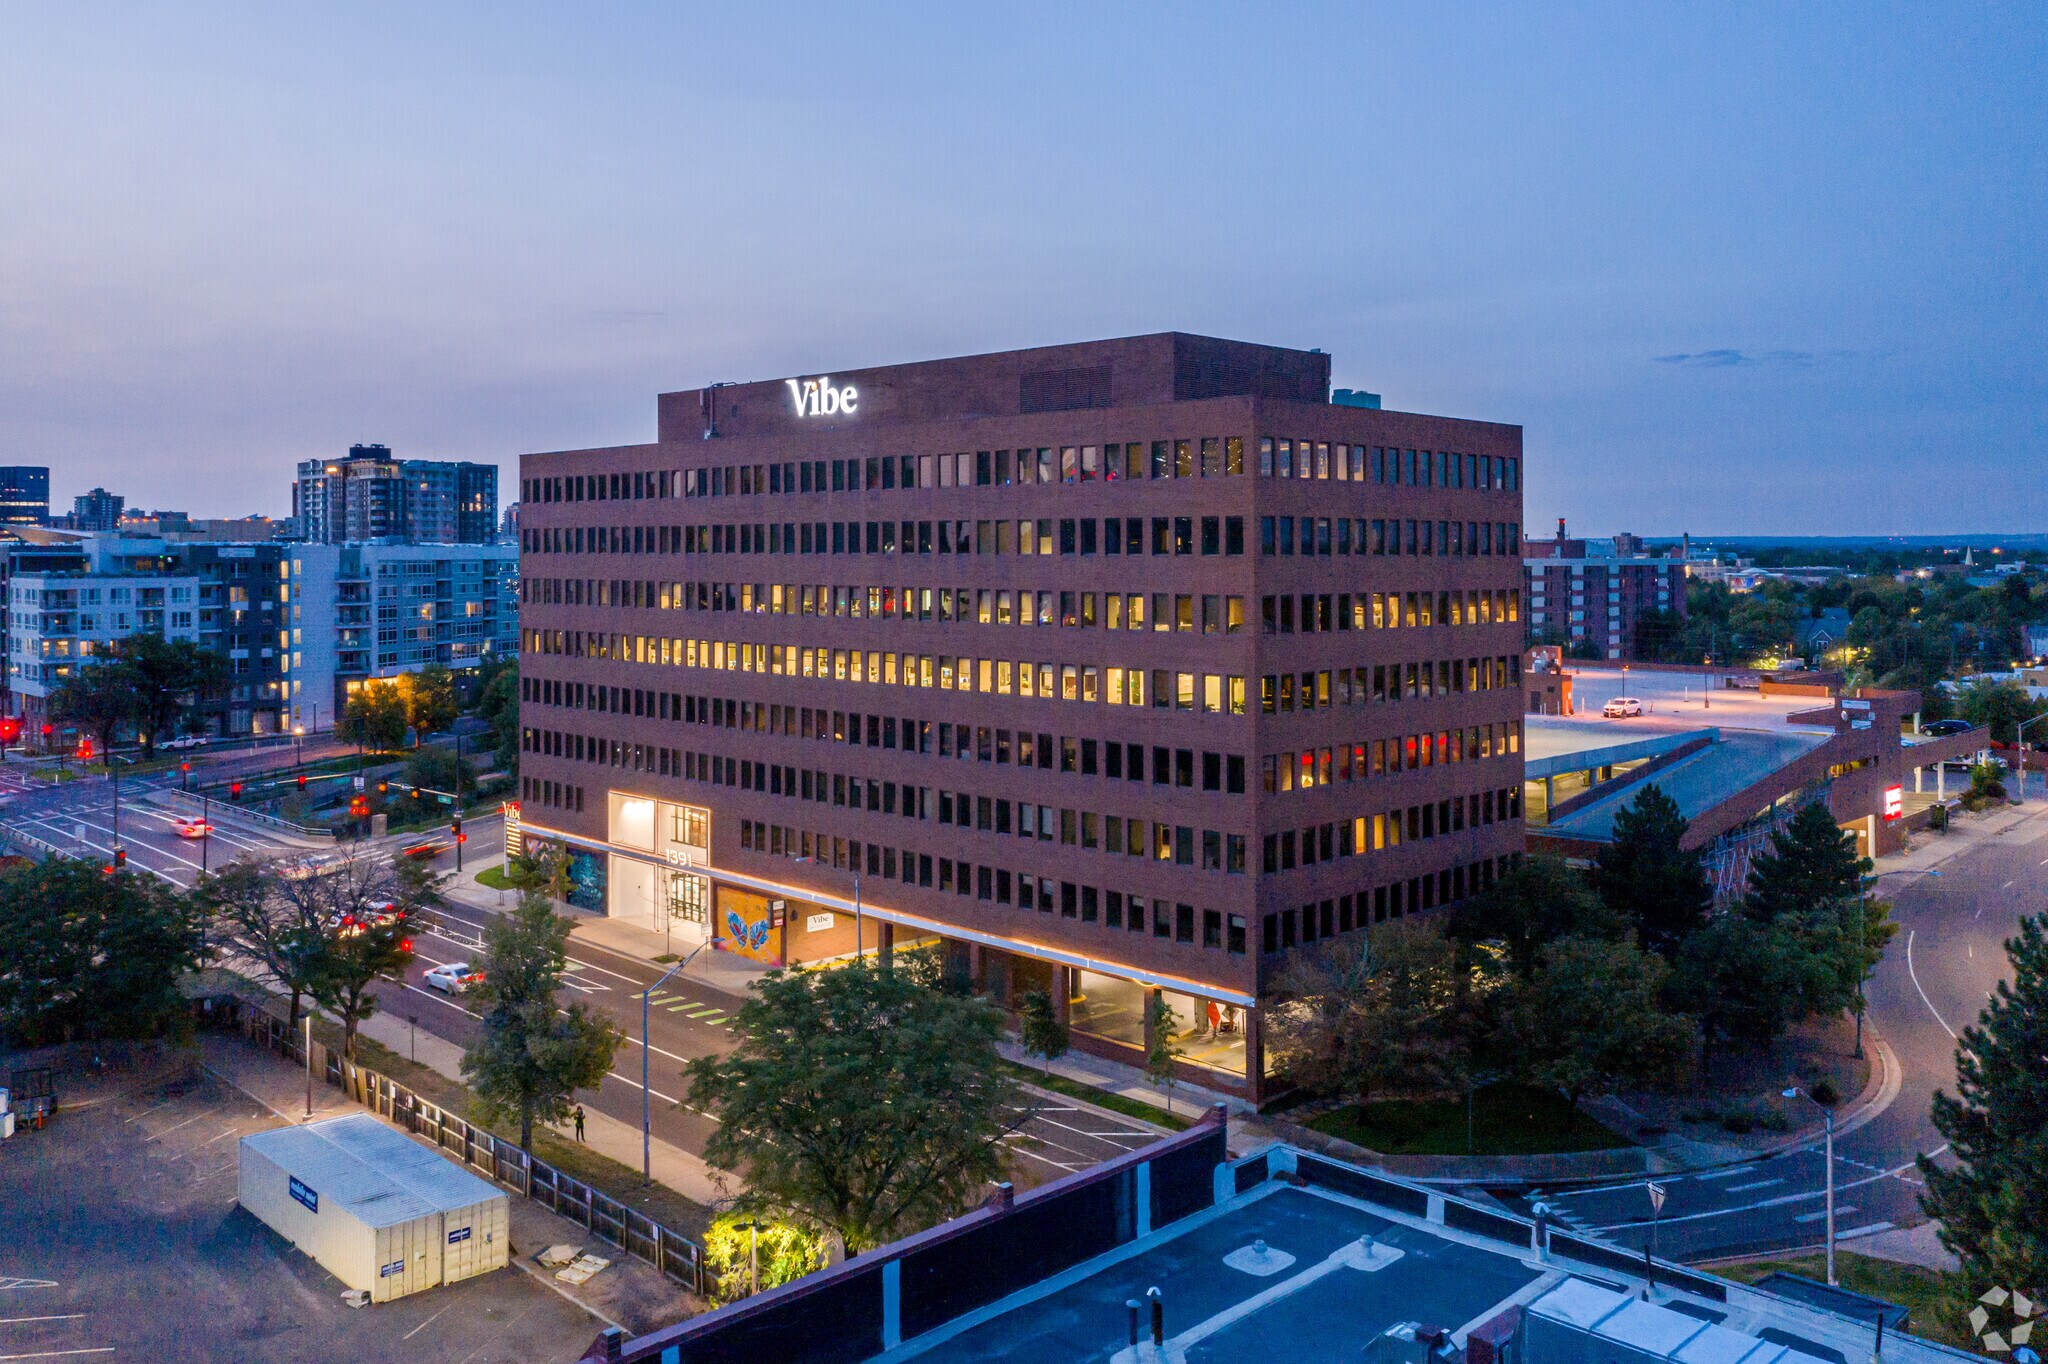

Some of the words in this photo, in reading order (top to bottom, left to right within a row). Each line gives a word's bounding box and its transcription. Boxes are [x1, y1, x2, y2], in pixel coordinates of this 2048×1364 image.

[785, 376, 858, 417] Vibe
[665, 848, 692, 867] 1391
[813, 915, 830, 924] Vibe
